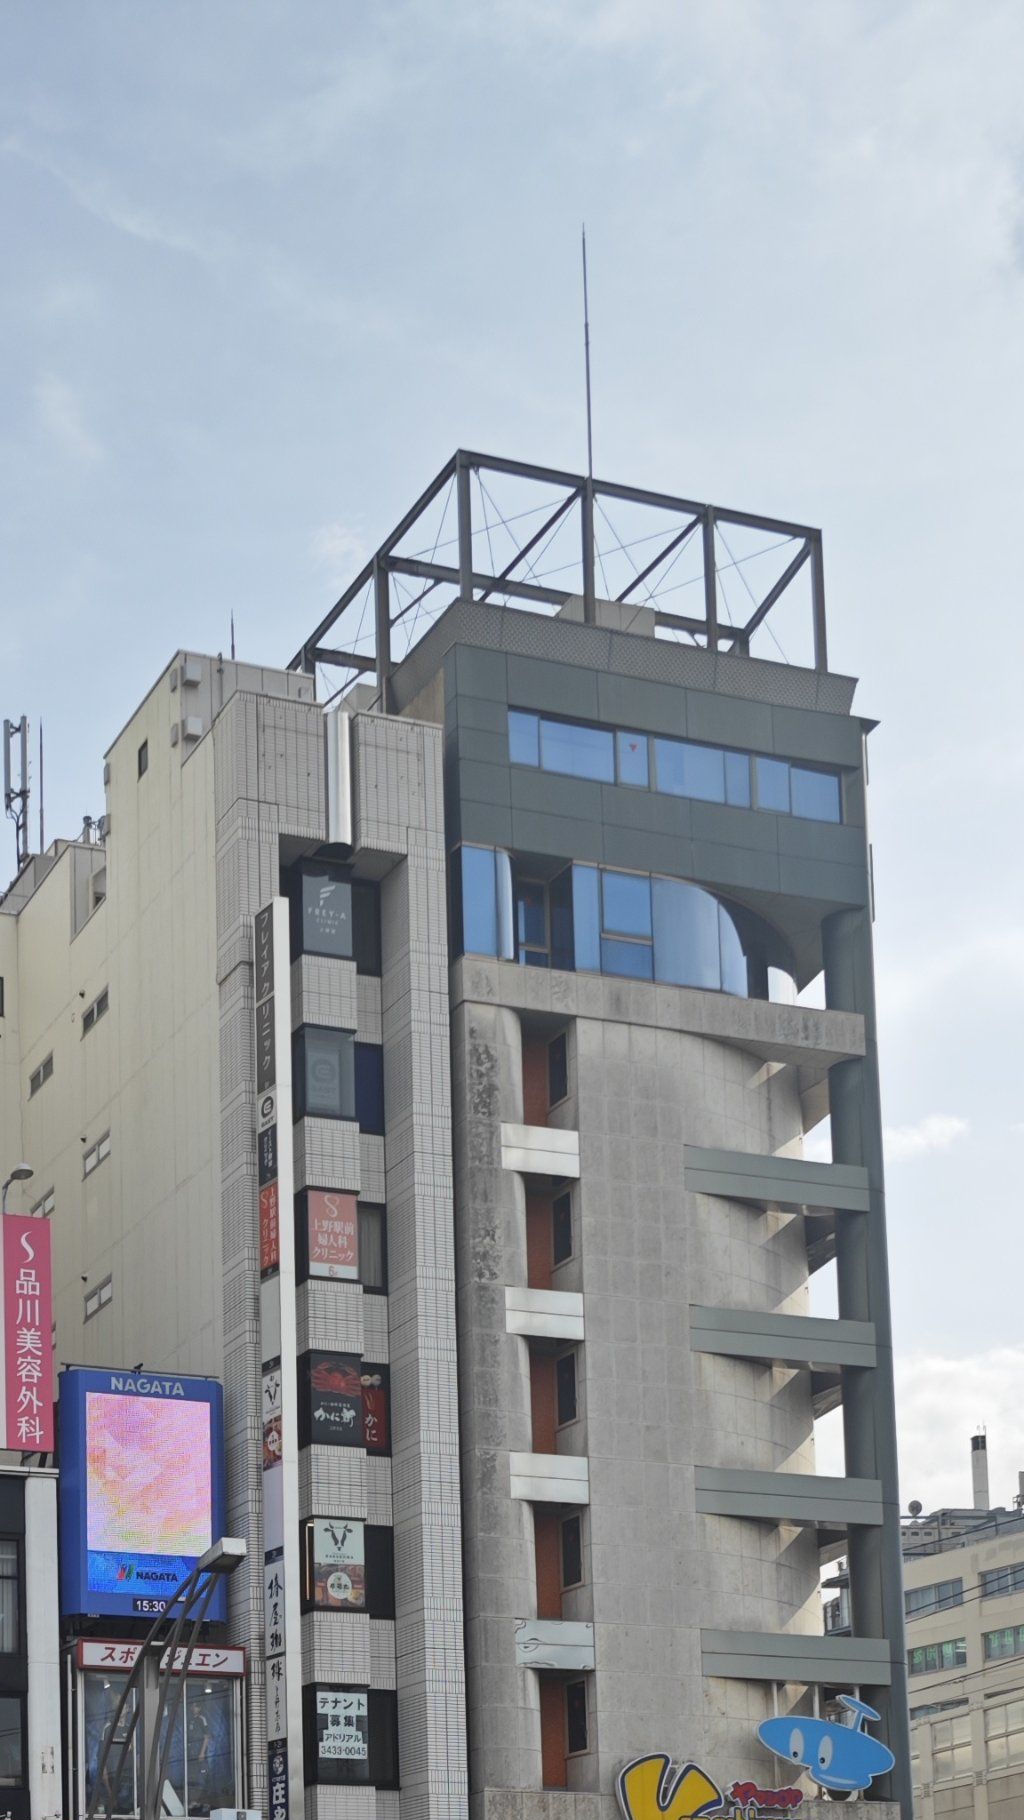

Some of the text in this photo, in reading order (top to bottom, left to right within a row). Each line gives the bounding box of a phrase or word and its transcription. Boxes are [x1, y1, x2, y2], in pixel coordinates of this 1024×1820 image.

[313, 1218, 355, 1235] 上野駅前
[312, 1246, 354, 1262] クリニック
[15, 1269, 44, 1444] 品川美容外科
[110, 1377, 184, 1396] NAGATA
[136, 1571, 179, 1582] NAGATA
[136, 1600, 166, 1612] 15:30
[100, 1647, 229, 1668] スポジュエン
[319, 1698, 365, 1711] テナント
[329, 1714, 356, 1727] 募集
